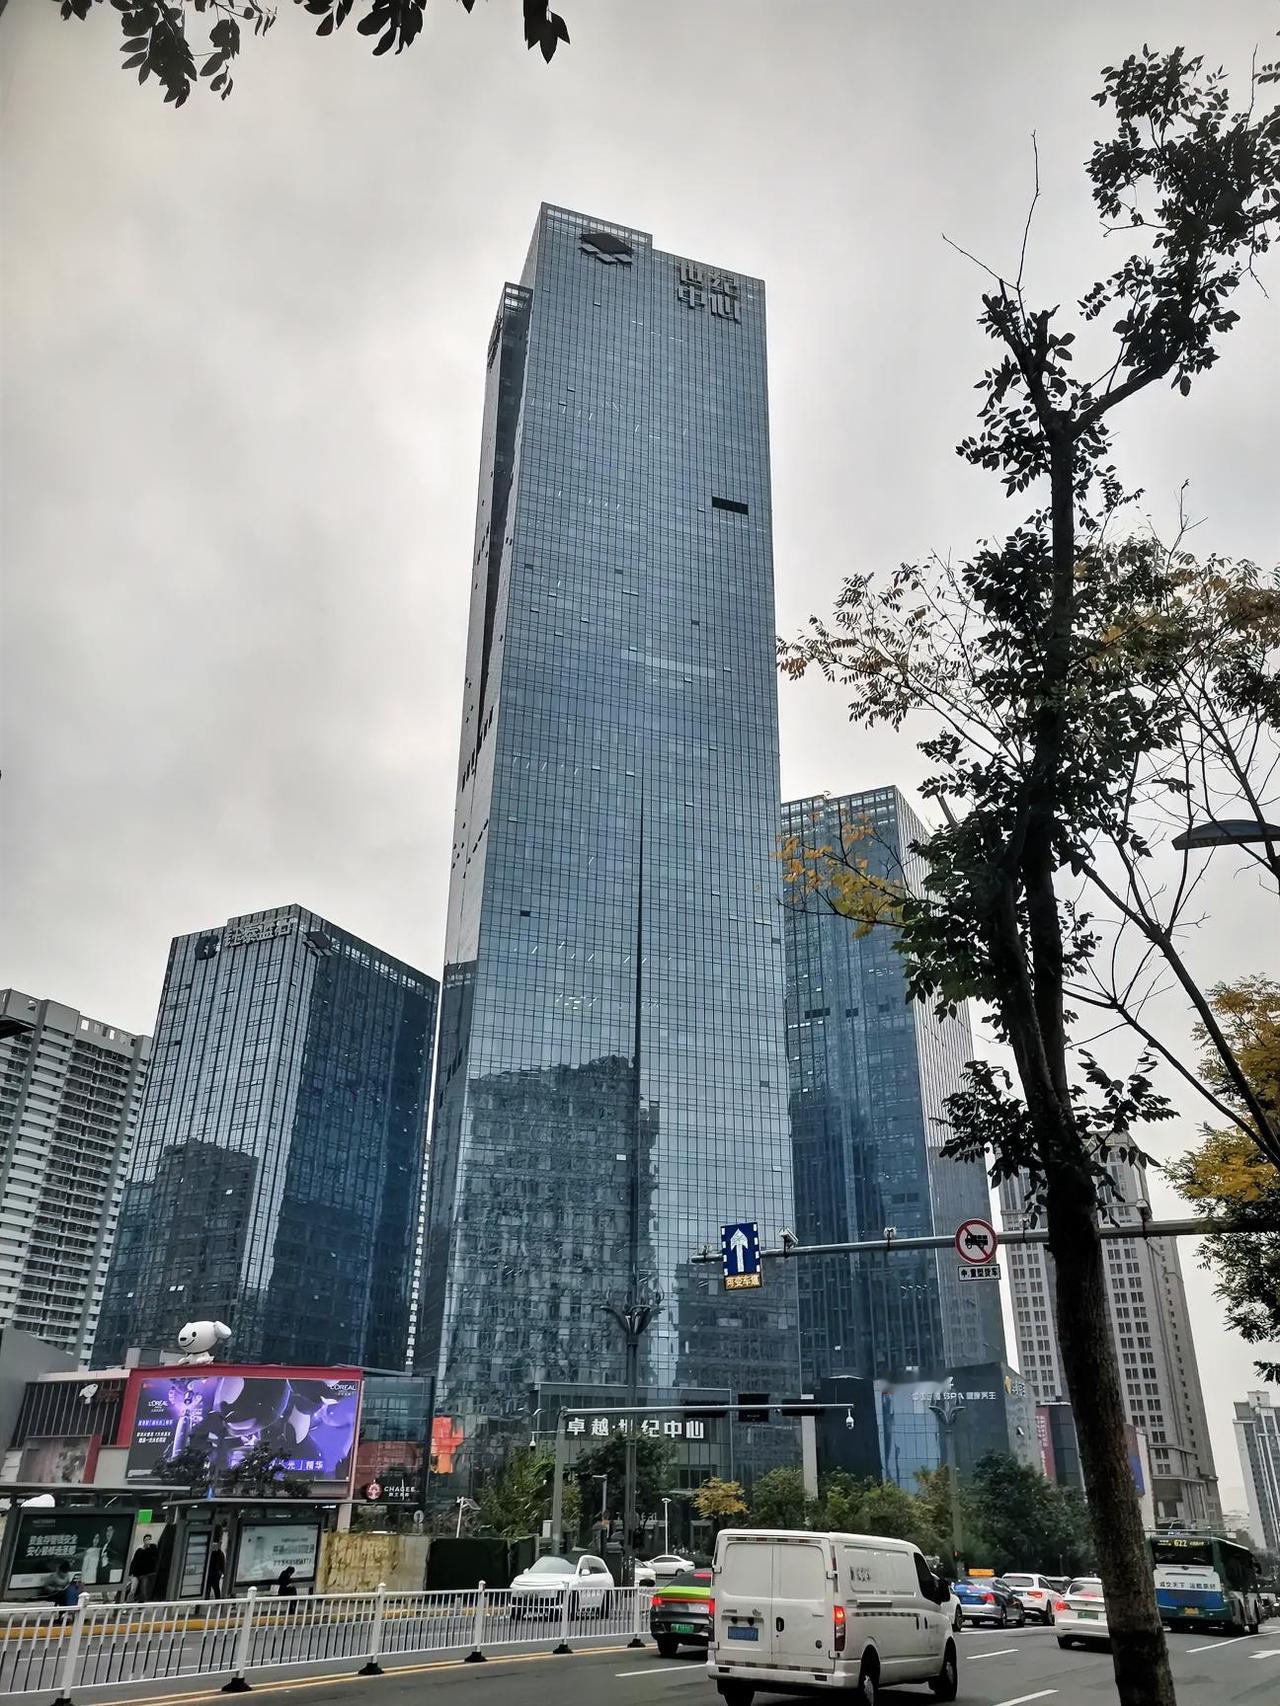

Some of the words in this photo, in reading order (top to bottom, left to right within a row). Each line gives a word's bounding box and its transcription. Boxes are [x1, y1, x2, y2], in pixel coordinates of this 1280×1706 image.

[680, 263, 740, 300] 世纪
[677, 286, 742, 325] 中心
[943, 1392, 965, 1400] SPA
